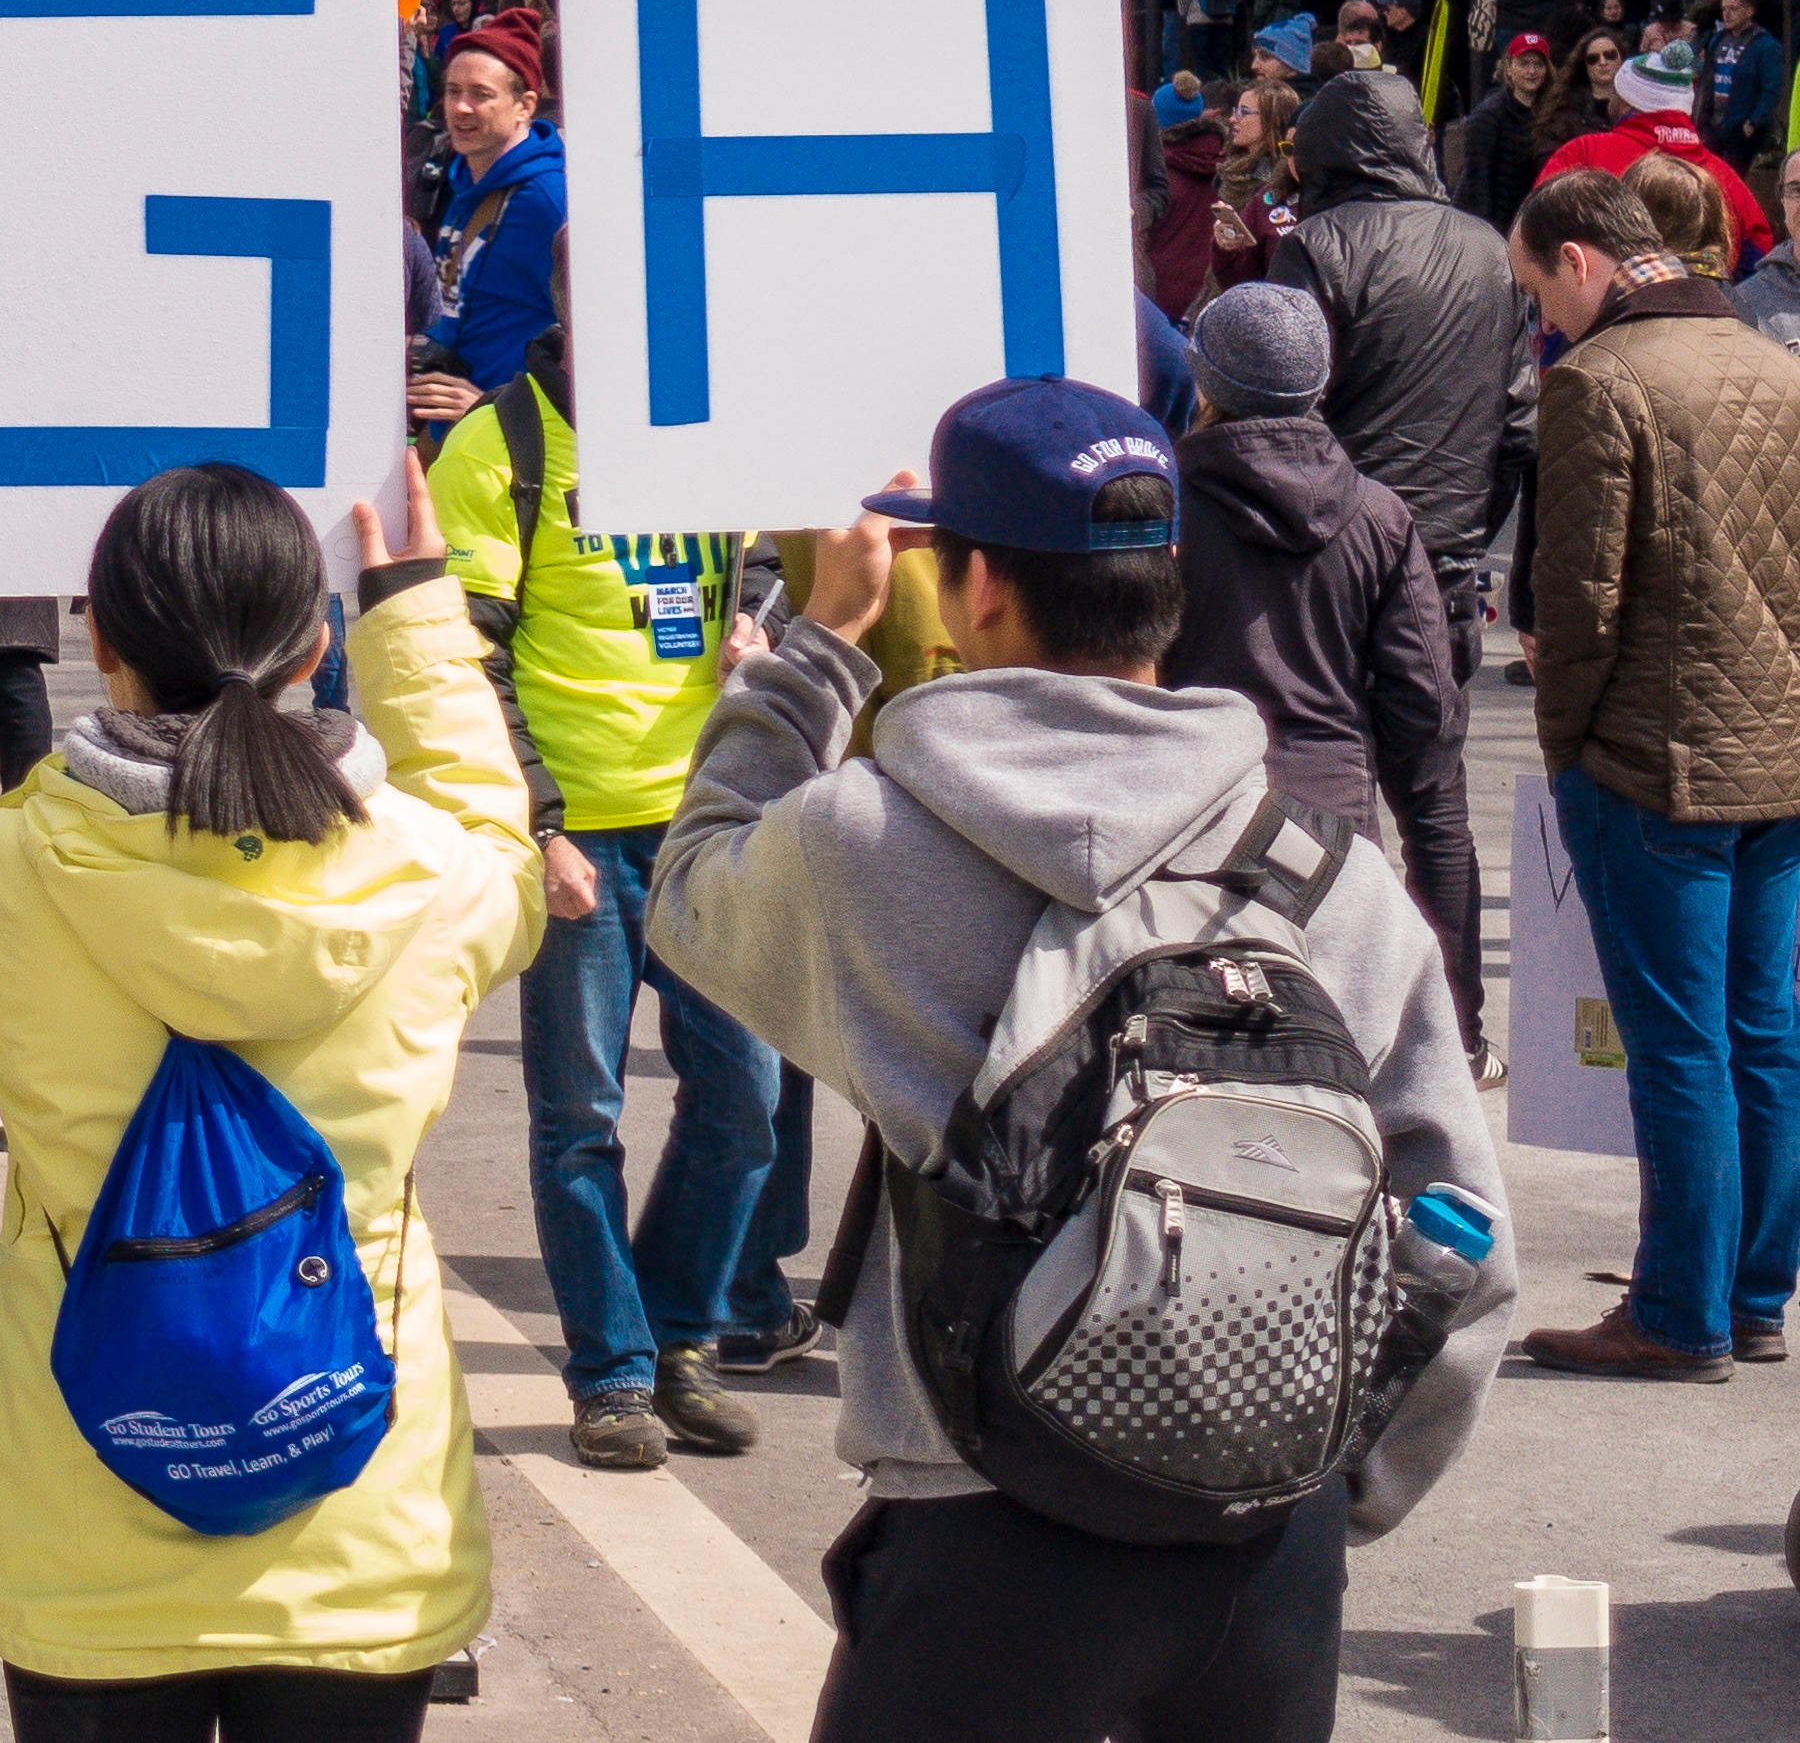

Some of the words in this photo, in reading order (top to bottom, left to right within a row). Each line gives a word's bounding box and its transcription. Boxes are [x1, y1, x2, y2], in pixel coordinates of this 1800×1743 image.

[1071, 452, 1099, 473] GO
[1090, 438, 1126, 464] FOR
[1124, 436, 1169, 470] BROKE
[573, 535, 603, 555] TO
[255, 1410, 279, 1426] Go
[279, 1384, 331, 1418] Sports
[329, 1362, 365, 1389] Tours
[105, 1420, 127, 1435] Go
[128, 1421, 187, 1438] Student
[187, 1423, 237, 1438] Tours
[167, 1463, 191, 1479] GO
[190, 1459, 242, 1479] Travel,
[241, 1453, 288, 1473] Learn,
[288, 1443, 302, 1458] &
[302, 1423, 335, 1450] Play!
